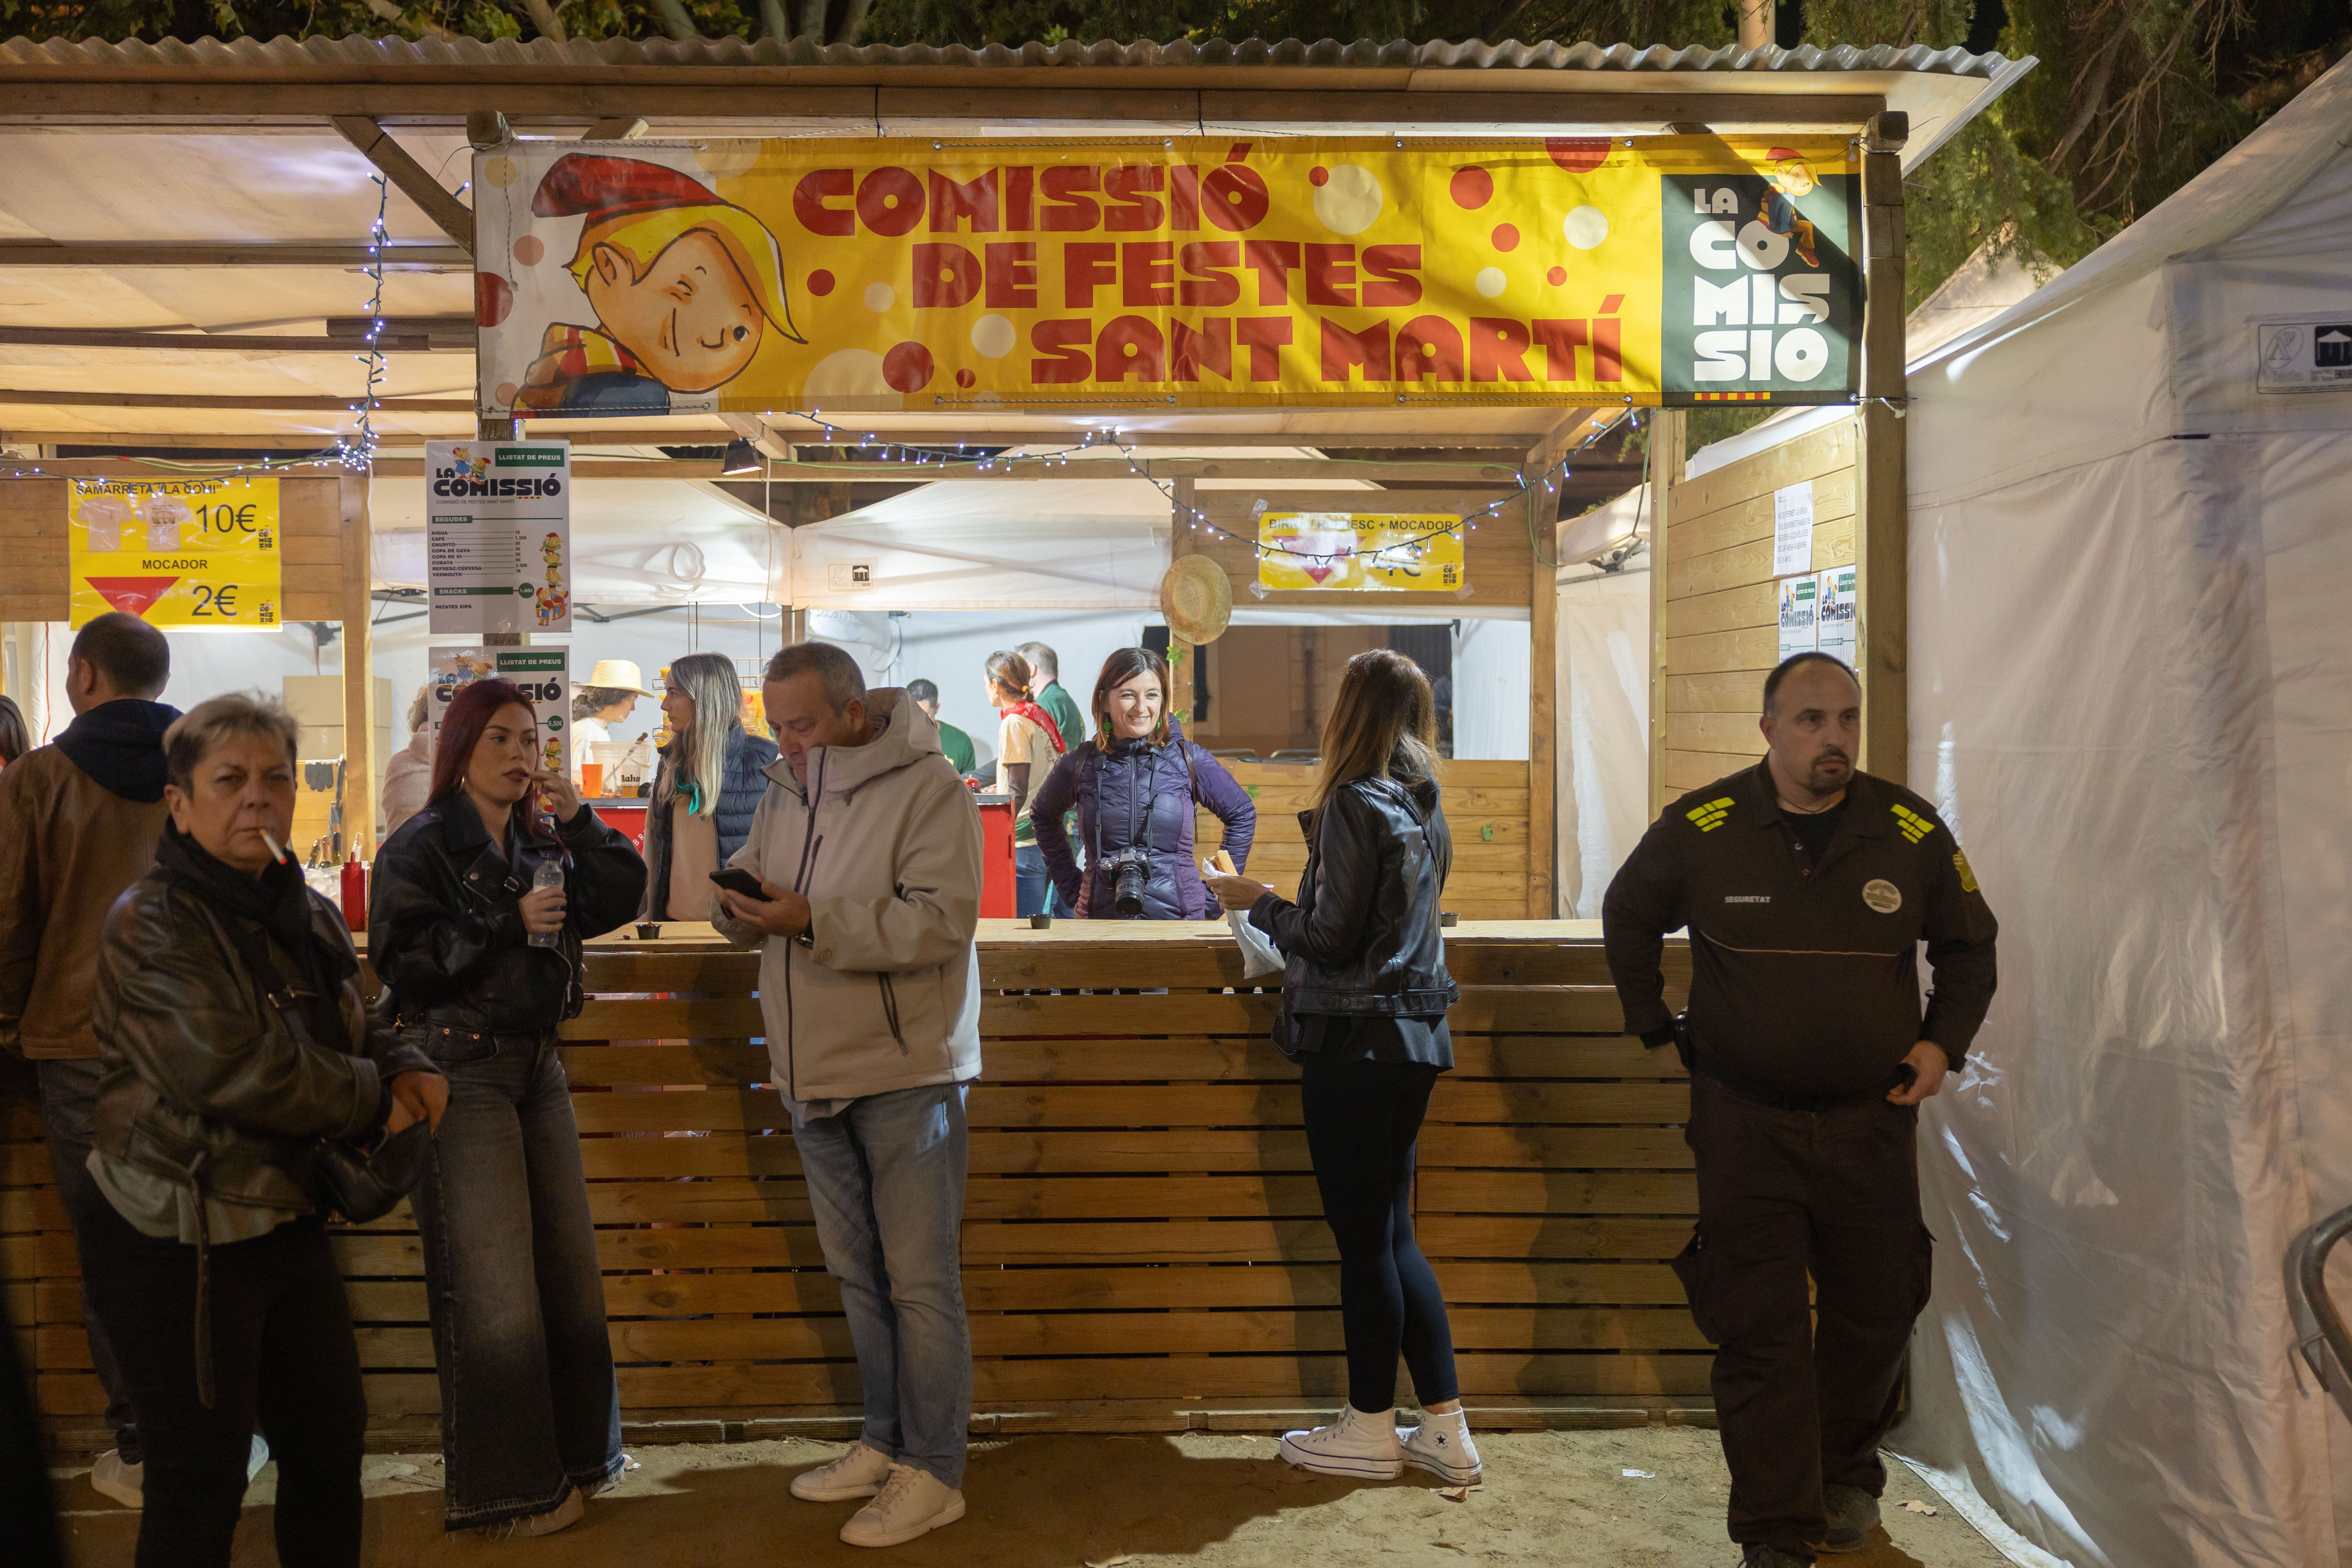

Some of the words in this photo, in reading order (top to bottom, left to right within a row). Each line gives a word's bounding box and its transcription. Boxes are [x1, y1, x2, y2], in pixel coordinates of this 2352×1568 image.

[793, 143, 1269, 236] COMISSIÓ
[1694, 188, 1739, 214] LA
[913, 241, 1037, 309] DE
[1064, 240, 1423, 309] FESTES
[1031, 314, 1293, 384] SANT
[1321, 294, 1626, 383] MARTÍ
[436, 468, 455, 478] LA
[76, 485, 154, 494] SAMARRETA
[434, 473, 561, 497] COMISSIÓ
[196, 504, 256, 532] 10€
[1389, 520, 1452, 530] MOCADOR
[142, 560, 208, 569] MOCADOR
[192, 585, 238, 616] 2€
[1781, 603, 1786, 612] LA
[1823, 595, 1828, 605] LA
[1781, 604, 1814, 628] COMISSIÓ
[1821, 602, 1856, 621] COMISSI
[438, 673, 457, 684] LA
